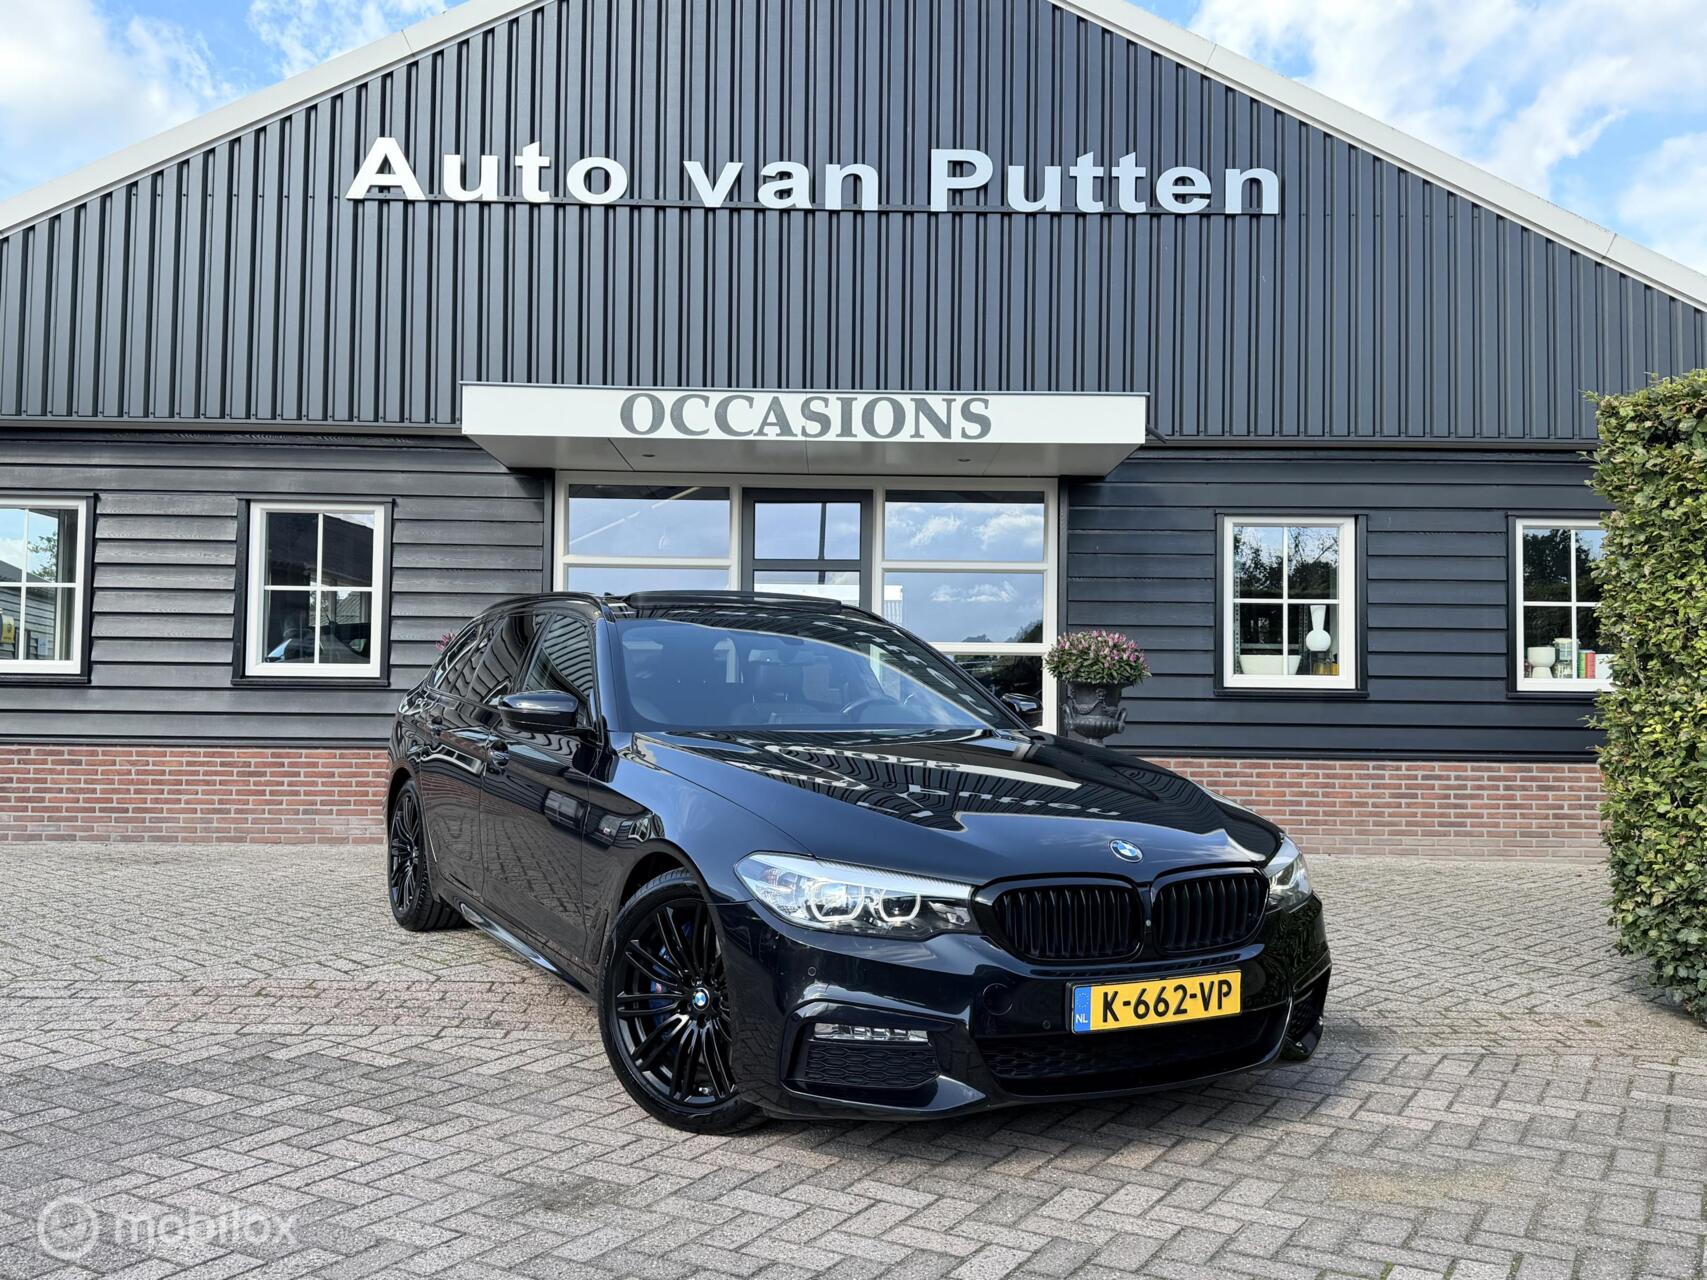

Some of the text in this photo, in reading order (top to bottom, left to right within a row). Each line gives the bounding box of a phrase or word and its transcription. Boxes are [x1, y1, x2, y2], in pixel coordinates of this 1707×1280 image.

[345, 137, 1279, 214] Auto van Putten
[620, 392, 992, 440] OCCASIONS
[1075, 1014, 1088, 1024] NL
[1102, 979, 1232, 1023] K-662-VP
